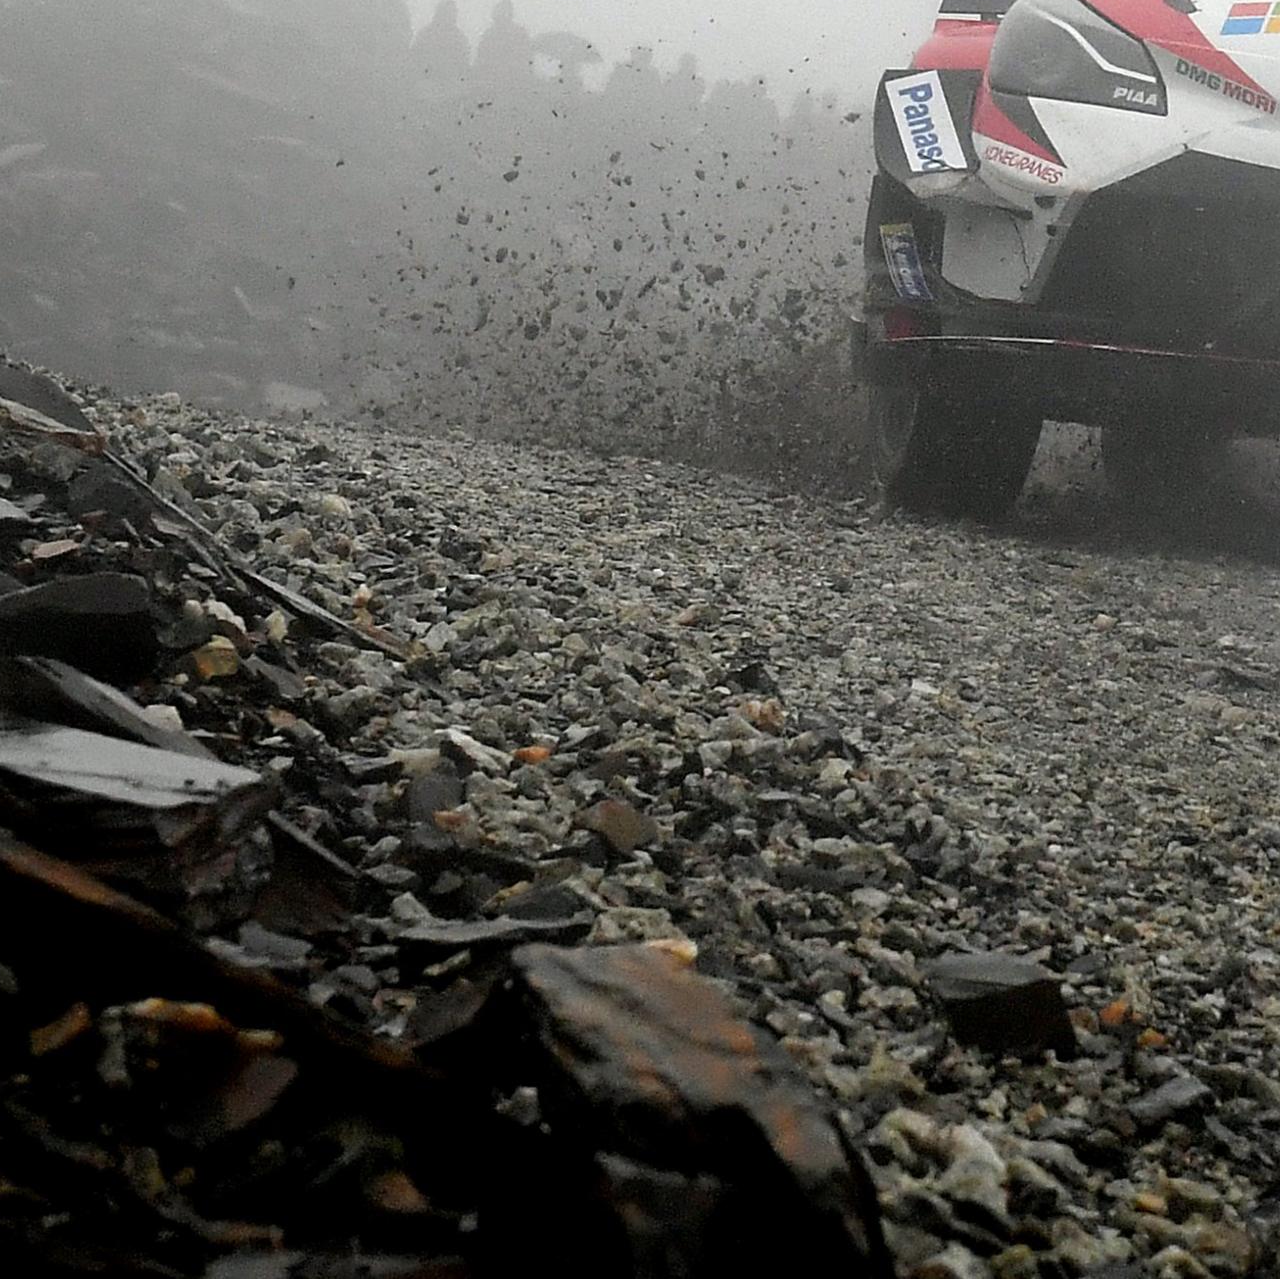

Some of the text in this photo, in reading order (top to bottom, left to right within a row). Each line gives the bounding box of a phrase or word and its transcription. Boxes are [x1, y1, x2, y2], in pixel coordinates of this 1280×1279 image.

[1112, 86, 1158, 107] PIAA
[1175, 58, 1278, 115] DMG MORI
